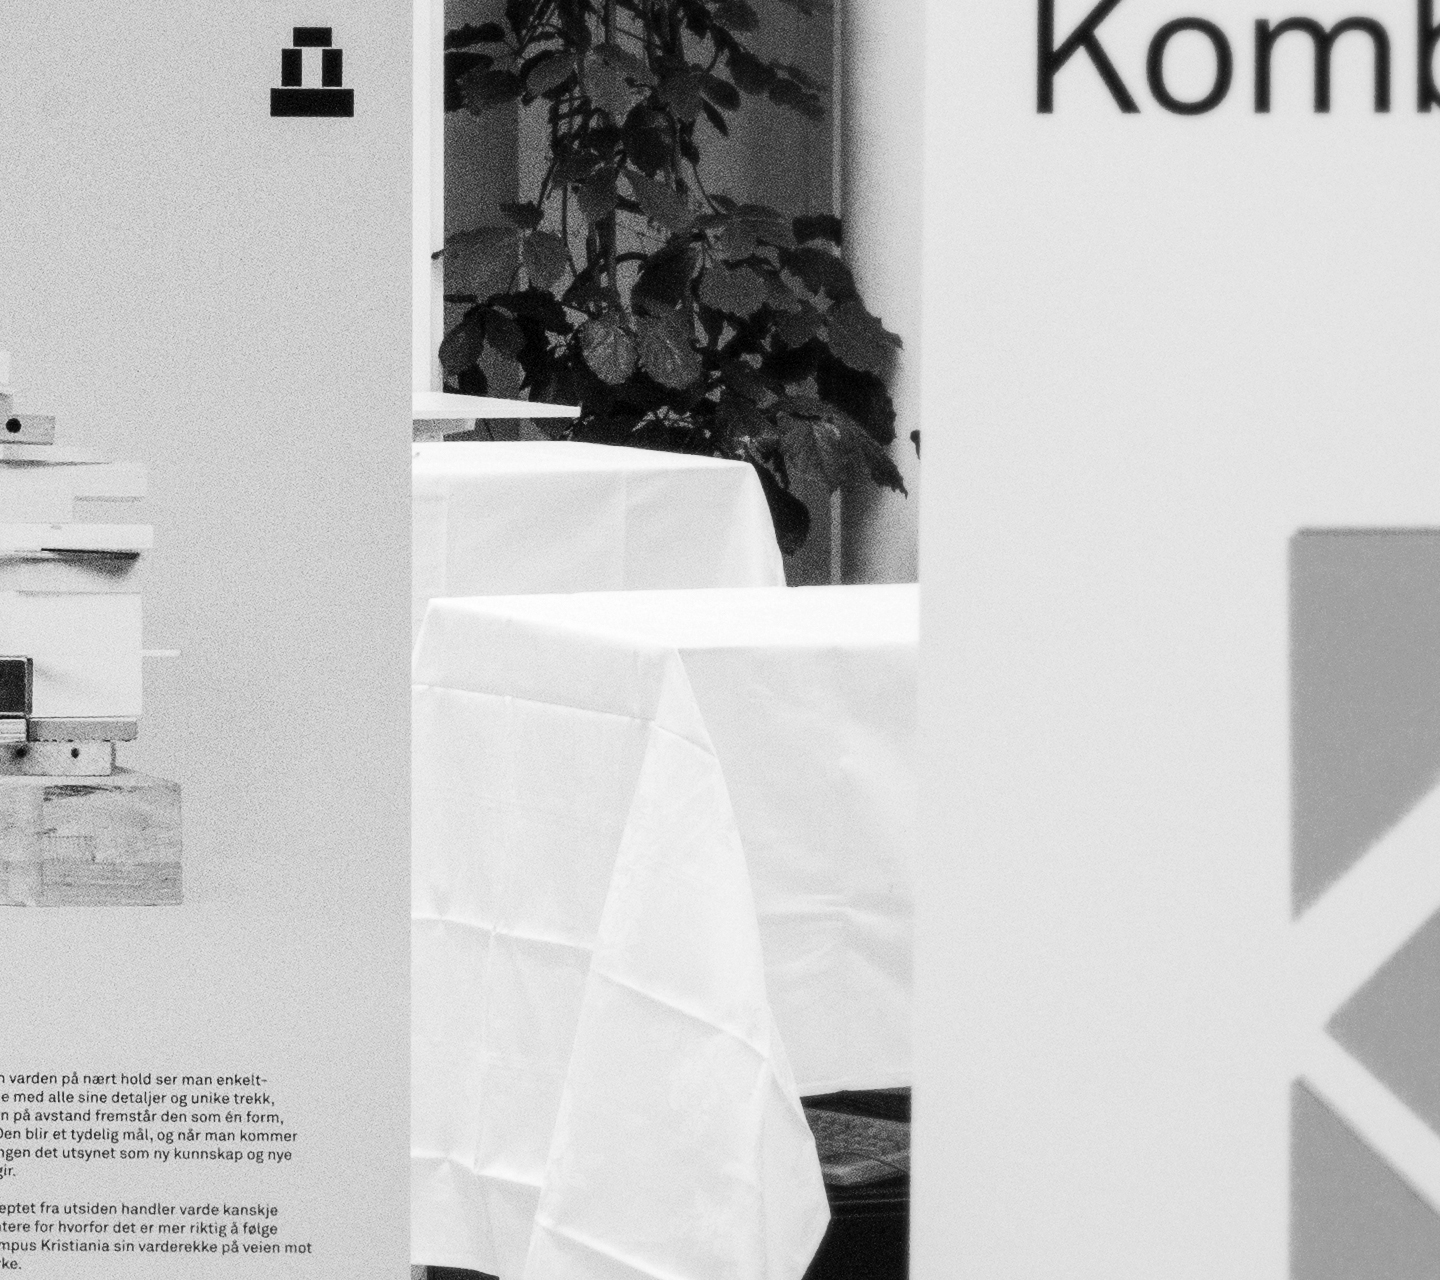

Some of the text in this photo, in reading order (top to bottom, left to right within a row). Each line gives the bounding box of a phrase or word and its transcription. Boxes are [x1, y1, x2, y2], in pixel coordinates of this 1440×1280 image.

[9, 1070, 58, 1084] varden
[61, 1069, 80, 1088] på
[82, 1070, 118, 1085] nært
[120, 1071, 152, 1085] hold
[155, 1075, 178, 1085] ser
[181, 1075, 213, 1086] man
[216, 1071, 267, 1086] enkelt-
[13, 1089, 45, 1103] med
[48, 1089, 75, 1103] alle
[77, 1089, 108, 1104] sine
[111, 1090, 167, 1108] detaljer
[170, 1094, 188, 1108] og
[190, 1090, 230, 1105] unike
[233, 1091, 275, 1108] trekk,
[24, 1125, 49, 1139] blir
[52, 1125, 67, 1139] et
[70, 1125, 119, 1143] tydelig
[122, 1125, 153, 1143] mål,
[156, 1130, 174, 1144] og
[177, 1125, 201, 1141] når
[204, 1130, 236, 1141] man
[239, 1127, 297, 1141] kommer
[39, 1200, 60, 1214] fra
[63, 1200, 118, 1215] utsiden
[120, 1201, 176, 1215] handler
[179, 1201, 220, 1216] varde
[222, 1202, 279, 1220] kanskje
[40, 1237, 110, 1252] Kristiania
[113, 1238, 135, 1252] sin
[138, 1238, 218, 1253] varderekke
[221, 1238, 240, 1256] på
[242, 1239, 281, 1253] veien
[284, 1239, 313, 1254] mot
